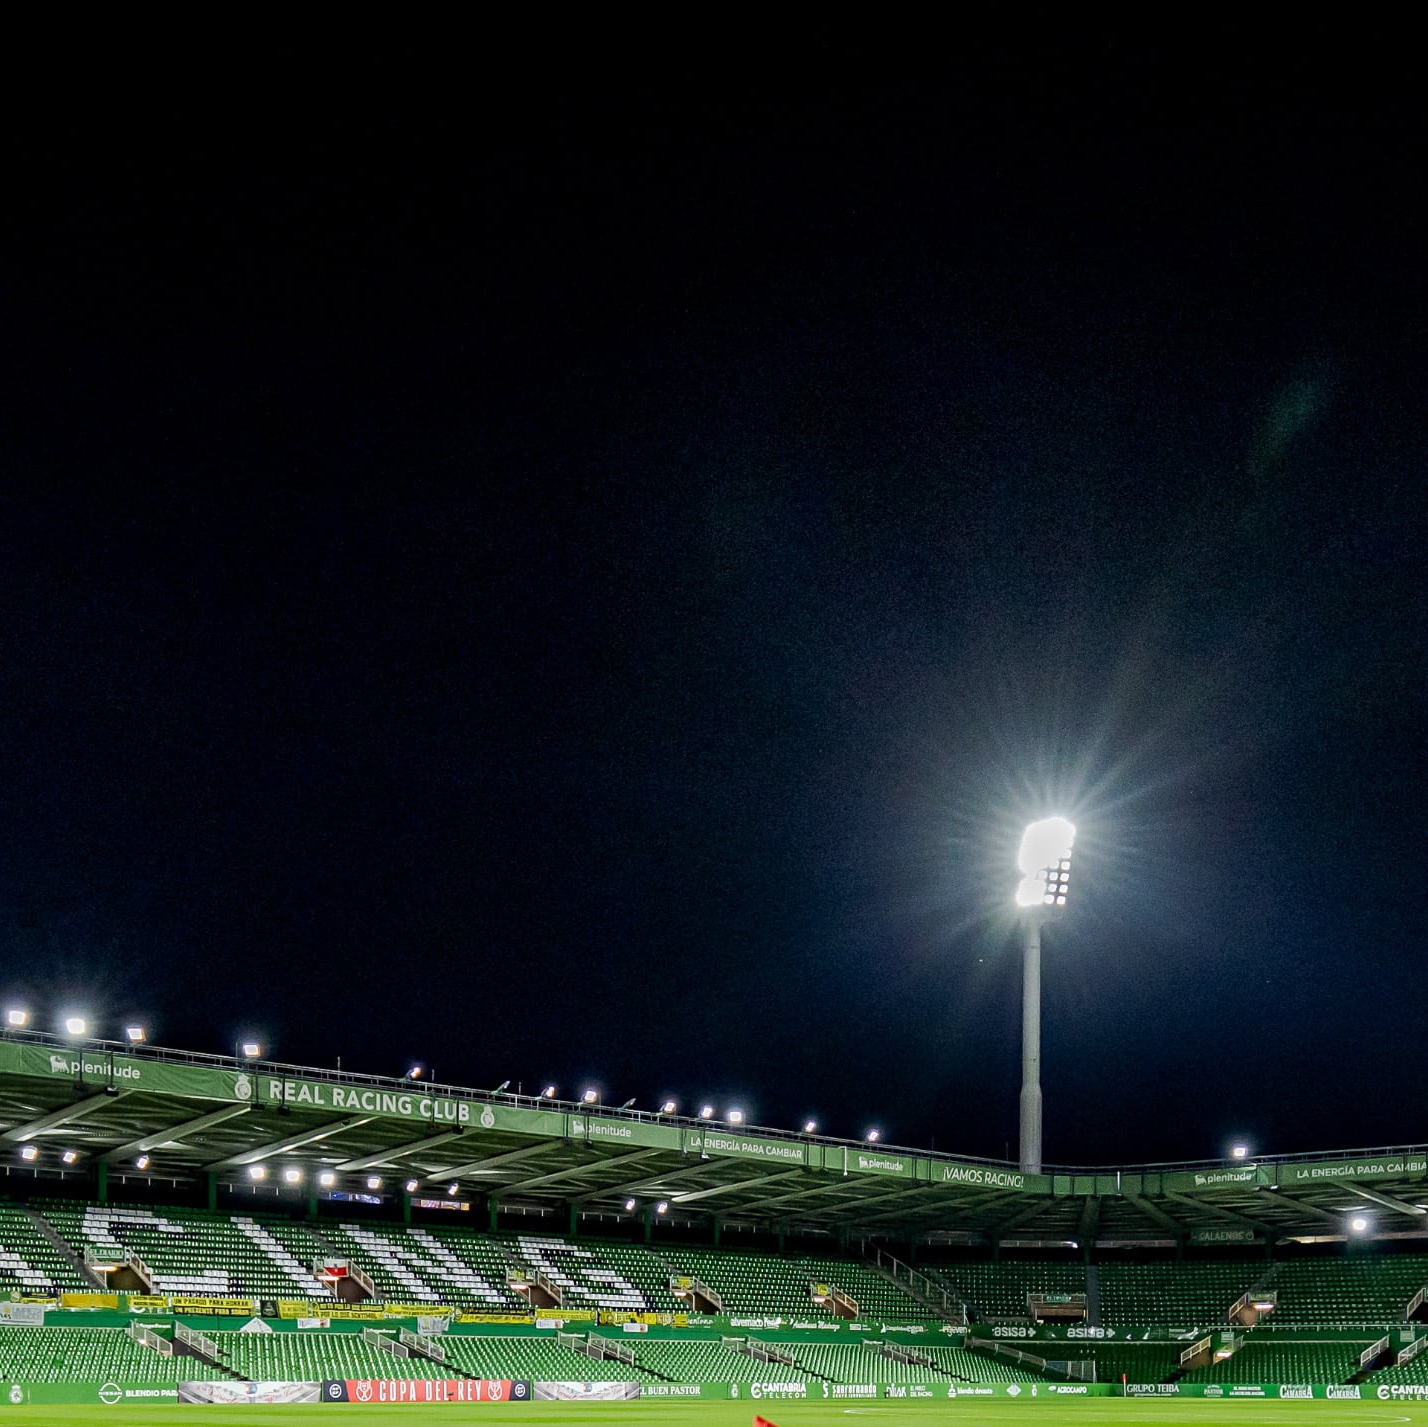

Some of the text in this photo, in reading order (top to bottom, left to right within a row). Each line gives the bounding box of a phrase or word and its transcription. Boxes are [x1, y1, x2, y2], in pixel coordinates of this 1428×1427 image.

[71, 1062, 141, 1079] plenitude
[269, 1080, 470, 1121] REAL RACING CLUB
[691, 1137, 803, 1159] LA ENERGÍA PARA CAMBIAR
[869, 1158, 904, 1172] plenitude
[1297, 1169, 1309, 1179] LA
[1311, 1165, 1356, 1178] ENERGÍA
[1357, 1164, 1385, 1176] PARA
[943, 1167, 1024, 1187] ¡VAMOS RACING!
[1207, 1172, 1252, 1184] plenitude
[993, 1326, 1026, 1338] asisa
[1067, 1326, 1106, 1339] asisa
[379, 1381, 482, 1401] COPA DEL REY
[648, 1386, 669, 1395] BUEN
[672, 1386, 701, 1395] PASTOR
[762, 1383, 807, 1392] CANTABRIA
[1126, 1384, 1180, 1393] GRUPO TEIBA
